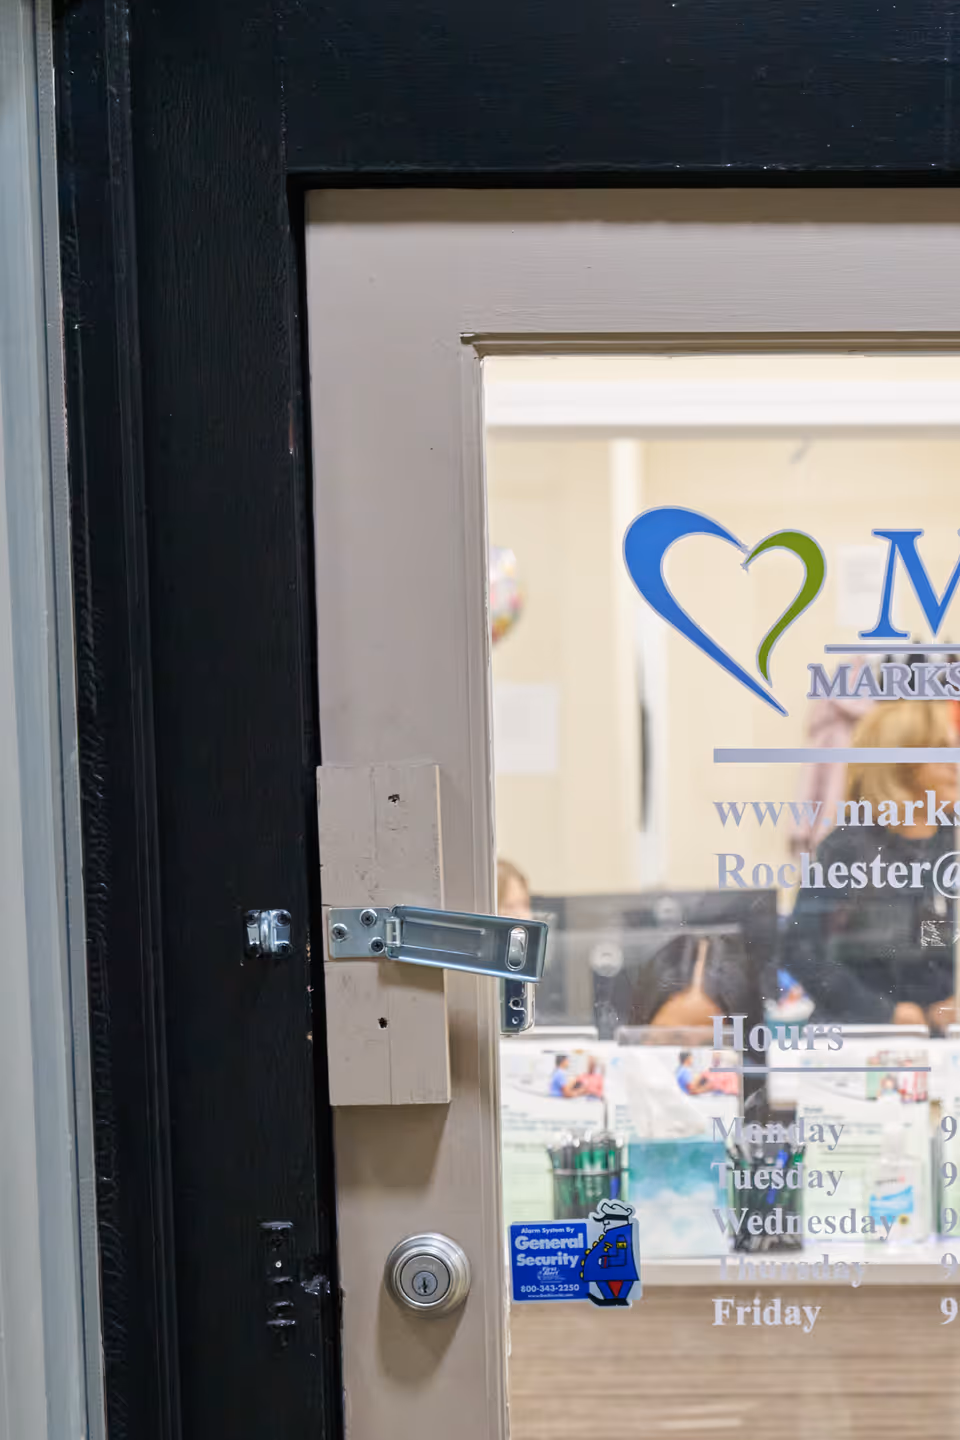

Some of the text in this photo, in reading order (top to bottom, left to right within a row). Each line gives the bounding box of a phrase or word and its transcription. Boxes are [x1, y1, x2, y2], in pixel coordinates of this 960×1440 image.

[709, 1015, 844, 1052] Hours
[711, 1116, 845, 1151] Monday
[710, 1161, 844, 1196] Tuesday
[514, 1233, 584, 1250] General
[712, 1207, 897, 1241] Wednesday
[516, 1251, 579, 1268] Security
[713, 1253, 870, 1288] Thursday
[520, 1284, 580, 1292] 800-343-2250
[711, 1296, 821, 1333] Friday
